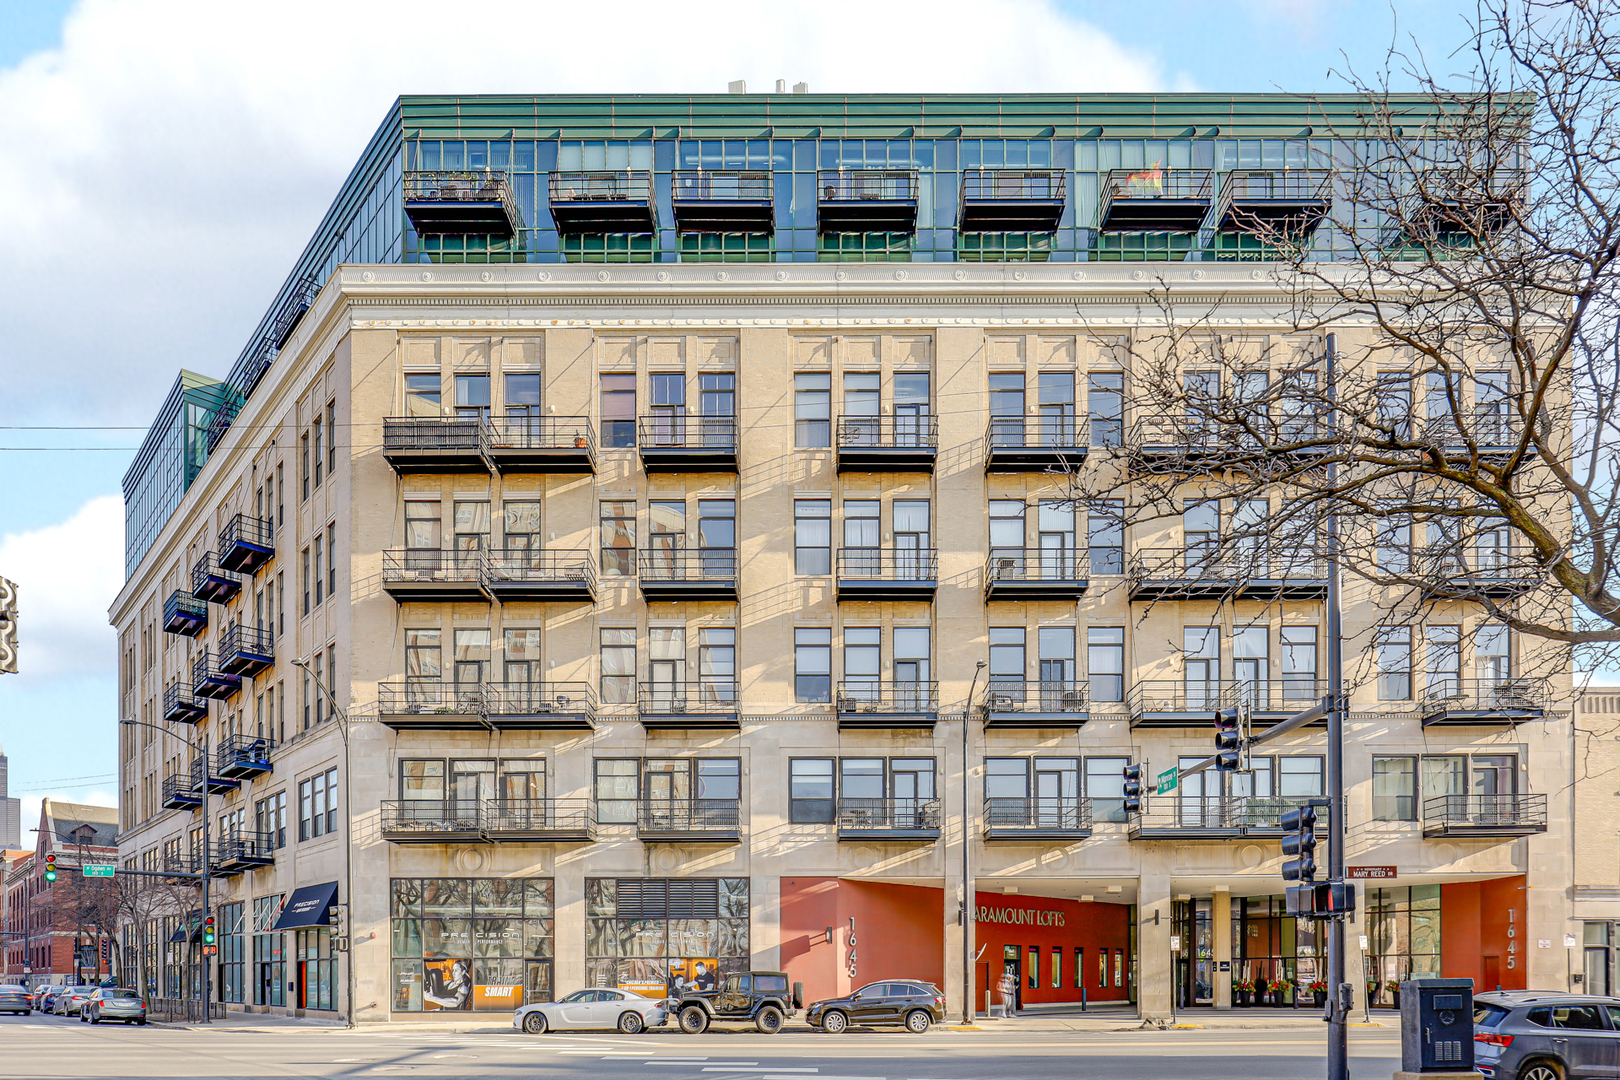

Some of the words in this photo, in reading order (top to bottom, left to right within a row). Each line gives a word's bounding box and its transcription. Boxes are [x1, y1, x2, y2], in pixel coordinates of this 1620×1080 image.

[294, 900, 320, 908] PRECISION
[974, 906, 1035, 925] ARAMOUNT
[1037, 910, 1066, 926] LOFTS
[849, 916, 857, 978] 1645
[1507, 908, 1516, 969] 1645
[484, 986, 514, 997] SMART
